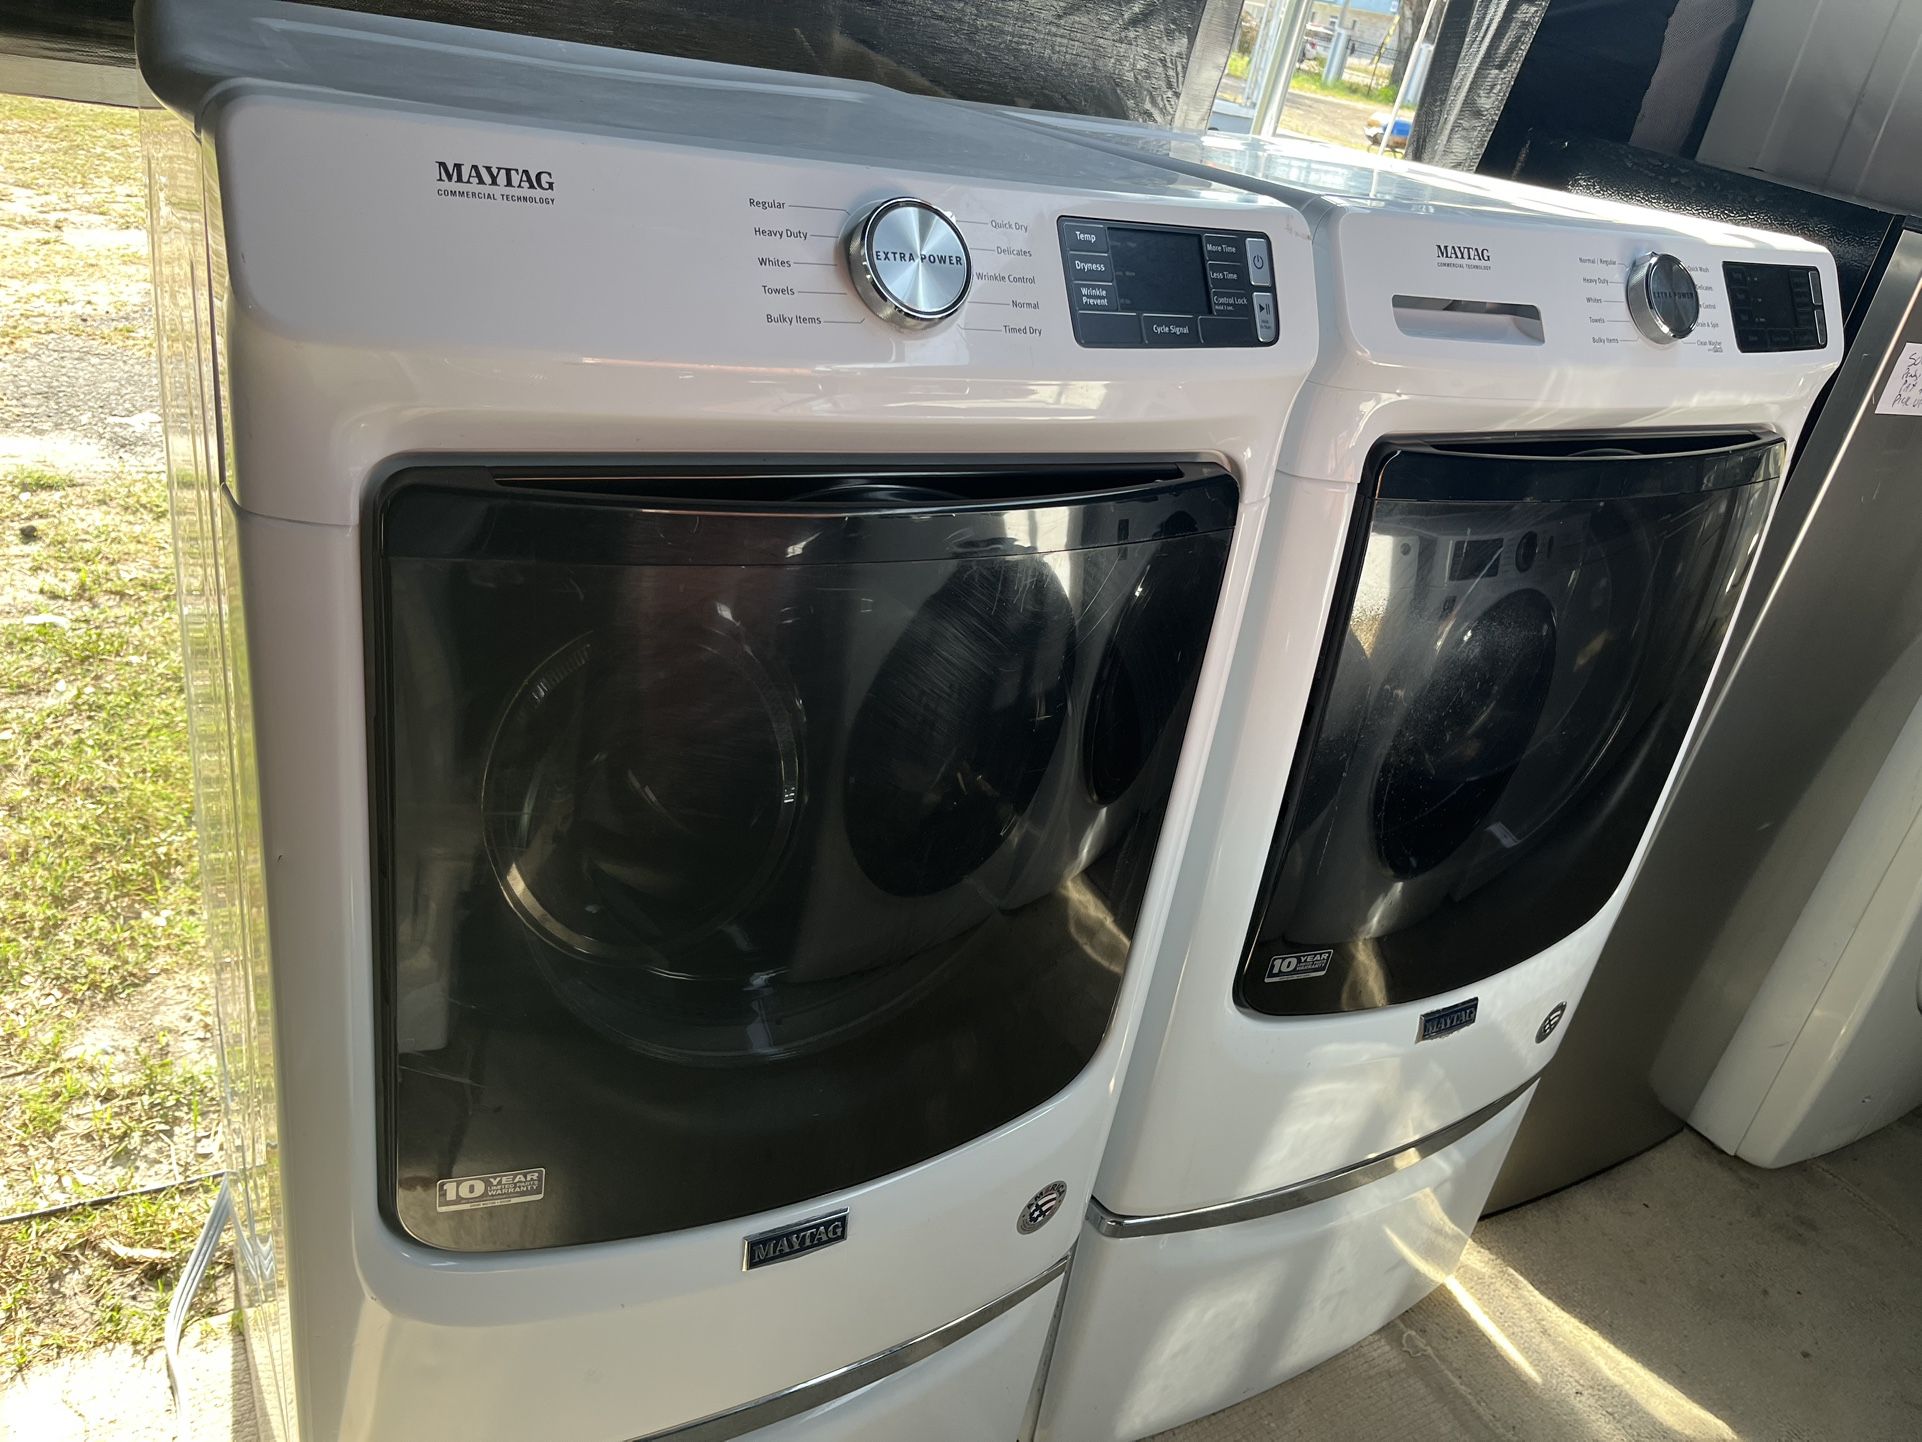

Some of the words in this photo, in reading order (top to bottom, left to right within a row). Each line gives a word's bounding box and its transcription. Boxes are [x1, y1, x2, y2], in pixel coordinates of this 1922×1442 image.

[435, 161, 555, 192] MAYTAG
[437, 188, 497, 201] COMMERCIAL
[500, 194, 555, 205] TECHNOLOGY
[749, 198, 786, 210] Regular
[990, 219, 1013, 230] Quick
[1014, 222, 1028, 233] Dry
[754, 227, 784, 239] Heavy
[786, 229, 808, 241] Duty
[1075, 232, 1096, 243] Temp
[996, 246, 1032, 258] Delicates
[1206, 243, 1222, 252] More
[1222, 245, 1236, 253] Time
[1436, 244, 1491, 262] MAYTAG
[757, 257, 791, 268] Whites
[875, 250, 915, 263] EXTRA
[920, 254, 963, 266] POWER
[1578, 257, 1596, 265] Normal
[1600, 258, 1617, 266] Regular
[1075, 261, 1105, 273] Dryness
[975, 272, 1006, 283] Wrinkle
[1007, 274, 1036, 285] Control
[1210, 271, 1223, 279] Less
[1224, 272, 1237, 280] Time
[1582, 277, 1597, 285] Heavy
[1598, 278, 1609, 286] Duty
[761, 285, 795, 295] Towels
[1081, 287, 1107, 297] Wrinkle
[1082, 296, 1108, 307] Prevent
[1214, 295, 1233, 304] Control
[1234, 297, 1248, 305] Lock
[1674, 292, 1694, 300] POWER
[1012, 300, 1039, 310] Normal
[766, 313, 793, 326] Bulky
[795, 315, 822, 325] Items
[1589, 316, 1605, 324] Towels
[1003, 325, 1027, 335] Timed
[1028, 326, 1042, 337] Dry
[1153, 324, 1169, 334] Cycle
[1169, 325, 1189, 335] Signal
[1592, 336, 1605, 344] Bulky
[1272, 957, 1297, 973] 10
[1300, 954, 1329, 962] YEAR
[1424, 1008, 1475, 1034] MAYTAG
[443, 1180, 486, 1201] 10
[489, 1172, 539, 1186] YEAR
[488, 1183, 514, 1191] LIMITED
[488, 1185, 538, 1196] WARRANTY
[753, 1221, 843, 1262] MAYTAG
